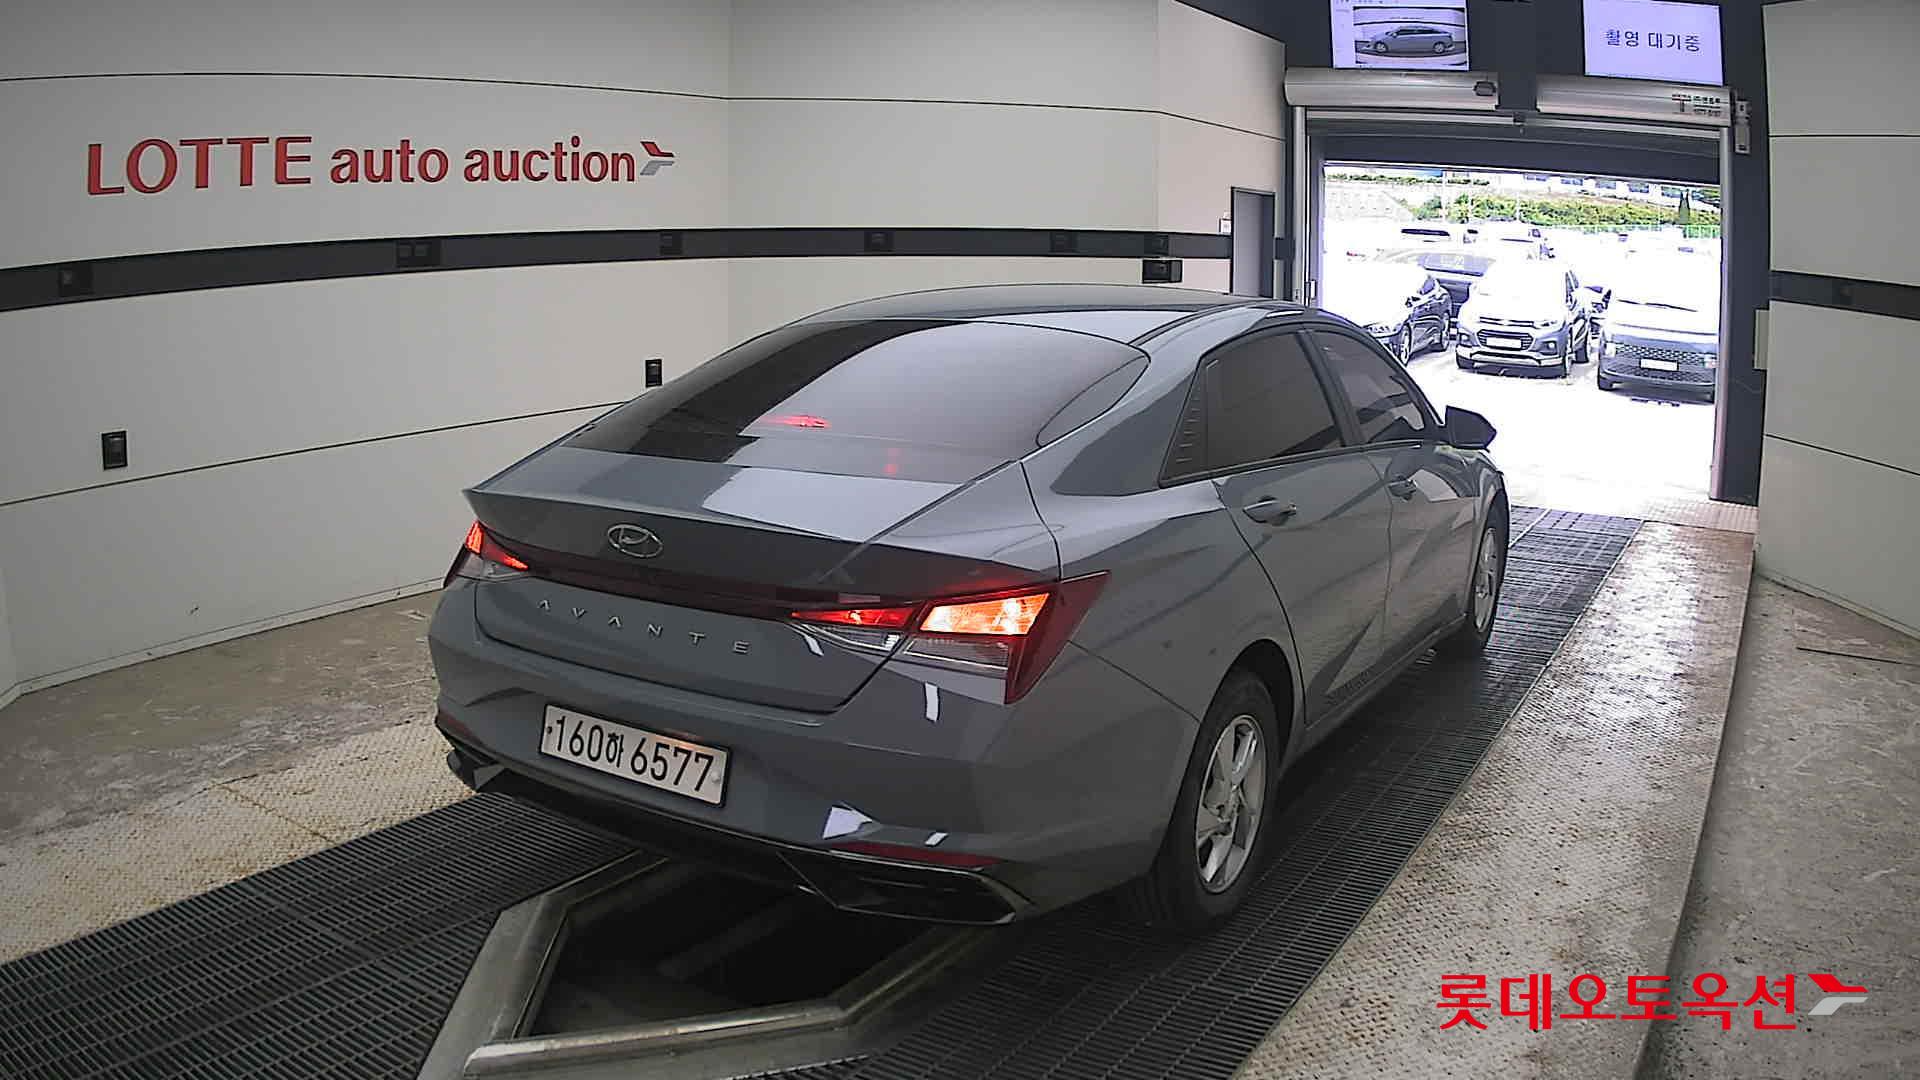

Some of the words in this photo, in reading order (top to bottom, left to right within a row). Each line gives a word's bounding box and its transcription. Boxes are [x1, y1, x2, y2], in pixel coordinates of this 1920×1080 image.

[1647, 32, 1701, 53] 대기중
[87, 136, 312, 196] LOTTE
[330, 139, 449, 184] auto
[463, 135, 636, 182] auction
[537, 599, 750, 655] AVANTE
